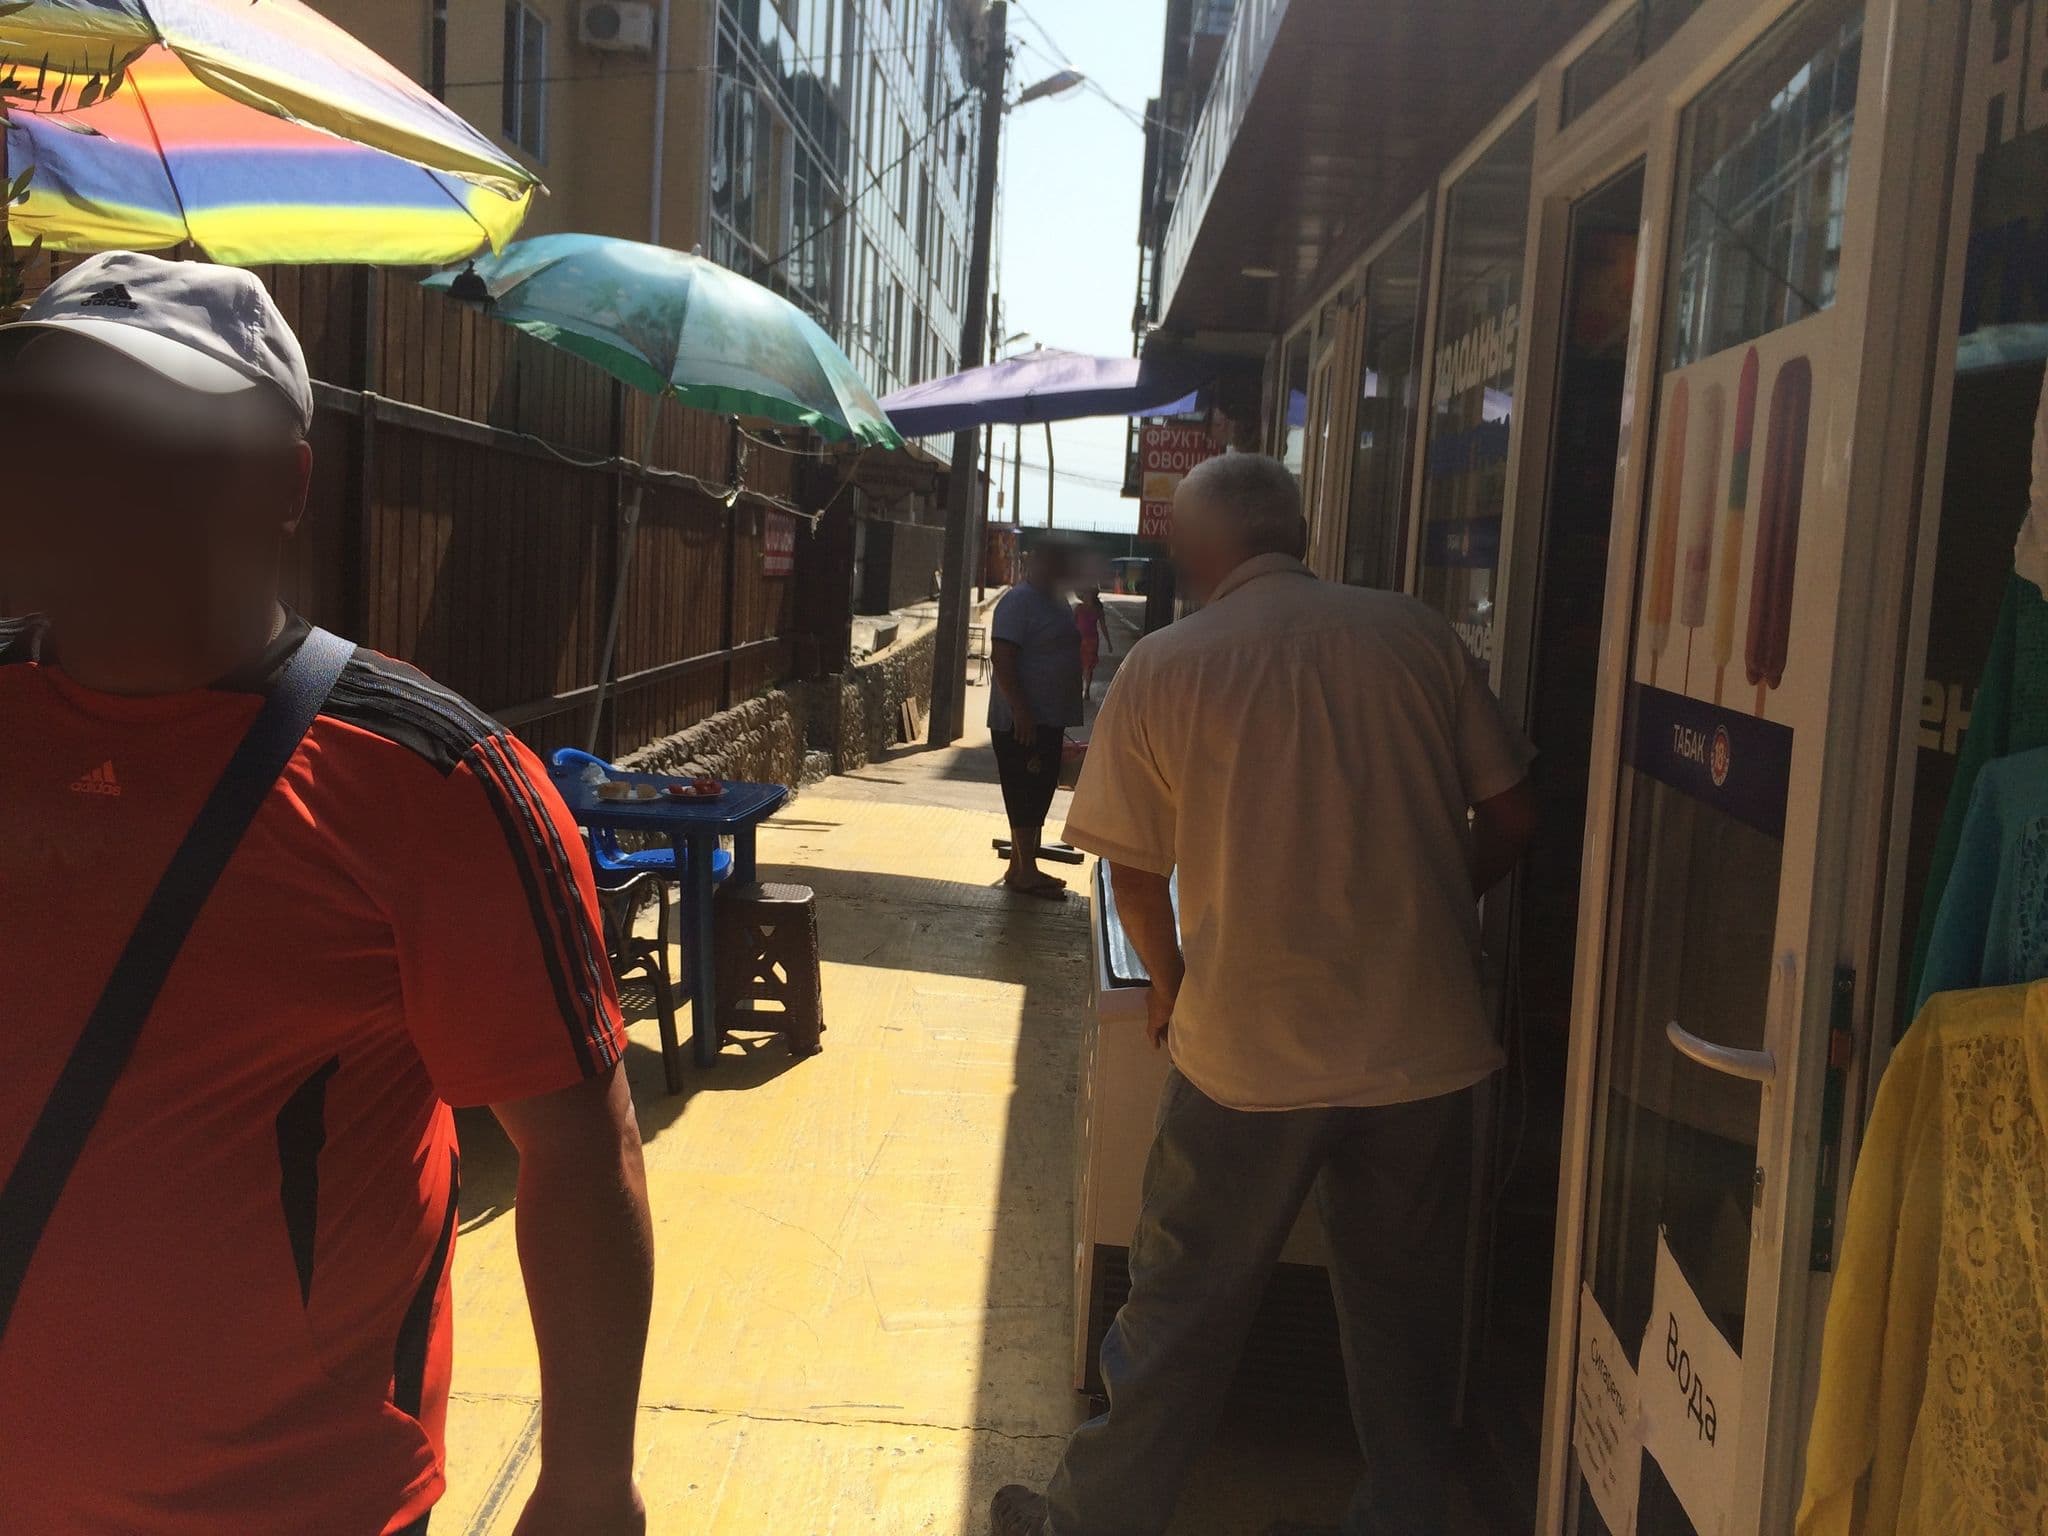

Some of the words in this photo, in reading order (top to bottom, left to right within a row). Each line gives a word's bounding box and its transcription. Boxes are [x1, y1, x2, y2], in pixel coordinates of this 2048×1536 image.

[81, 298, 138, 309] adidas
[1142, 518, 1171, 537] КУК
[1672, 724, 1706, 764] ТАБАК
[71, 780, 121, 796] adidas
[1665, 1311, 1717, 1448] Вода
